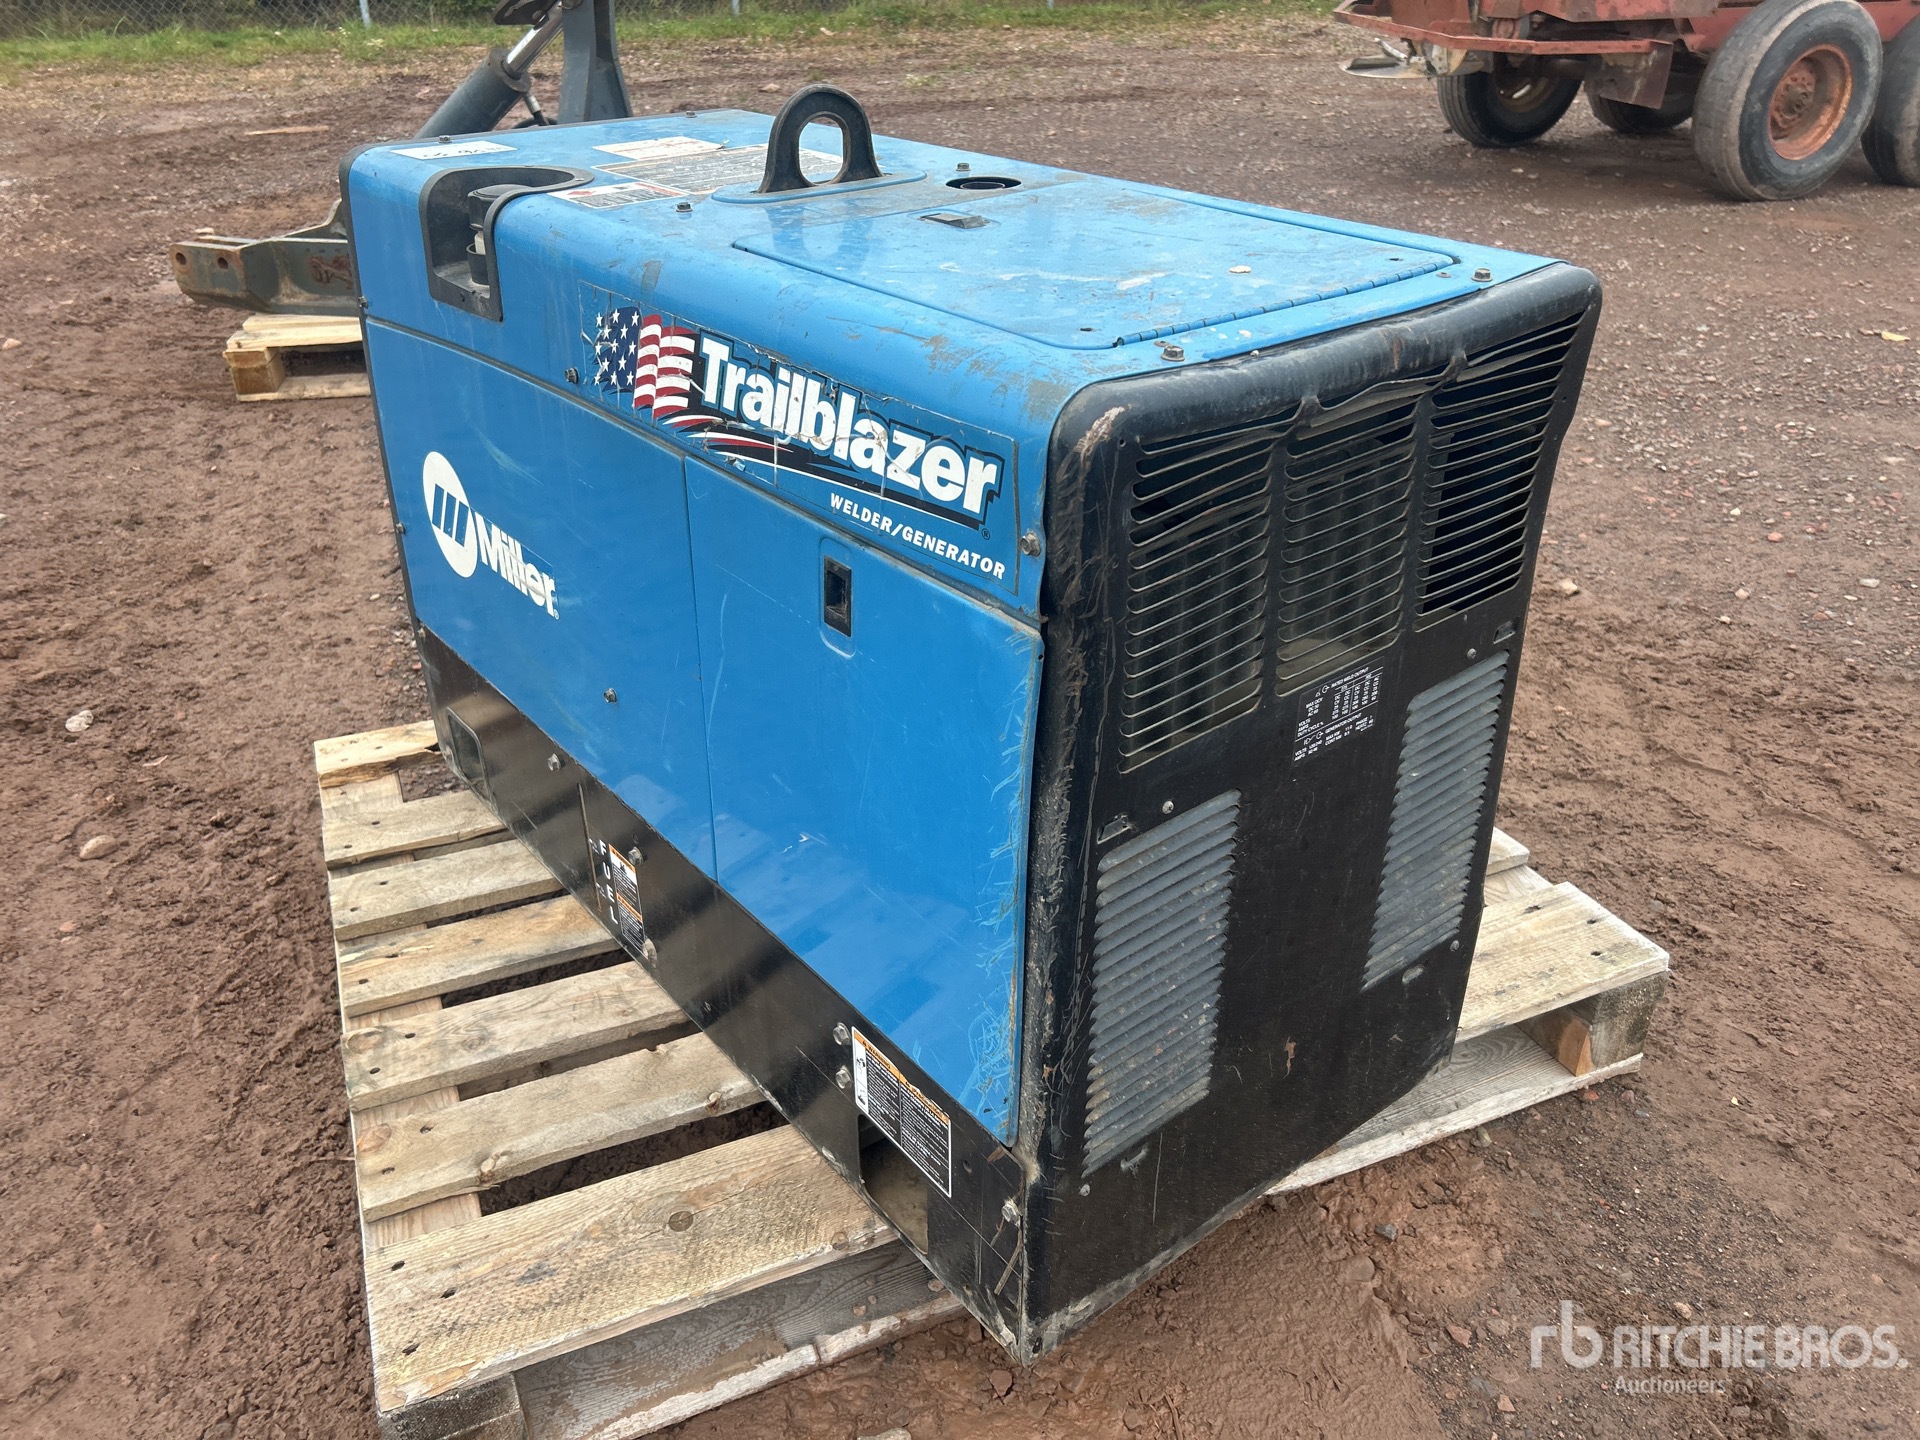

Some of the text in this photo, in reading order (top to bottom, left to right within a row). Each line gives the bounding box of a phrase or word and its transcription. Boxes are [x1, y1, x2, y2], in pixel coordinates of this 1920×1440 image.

[700, 338, 997, 514] Trailblazer
[475, 512, 556, 618] Miller
[830, 492, 1006, 581] WELDER/GENERATOR
[599, 839, 618, 925] FUEL
